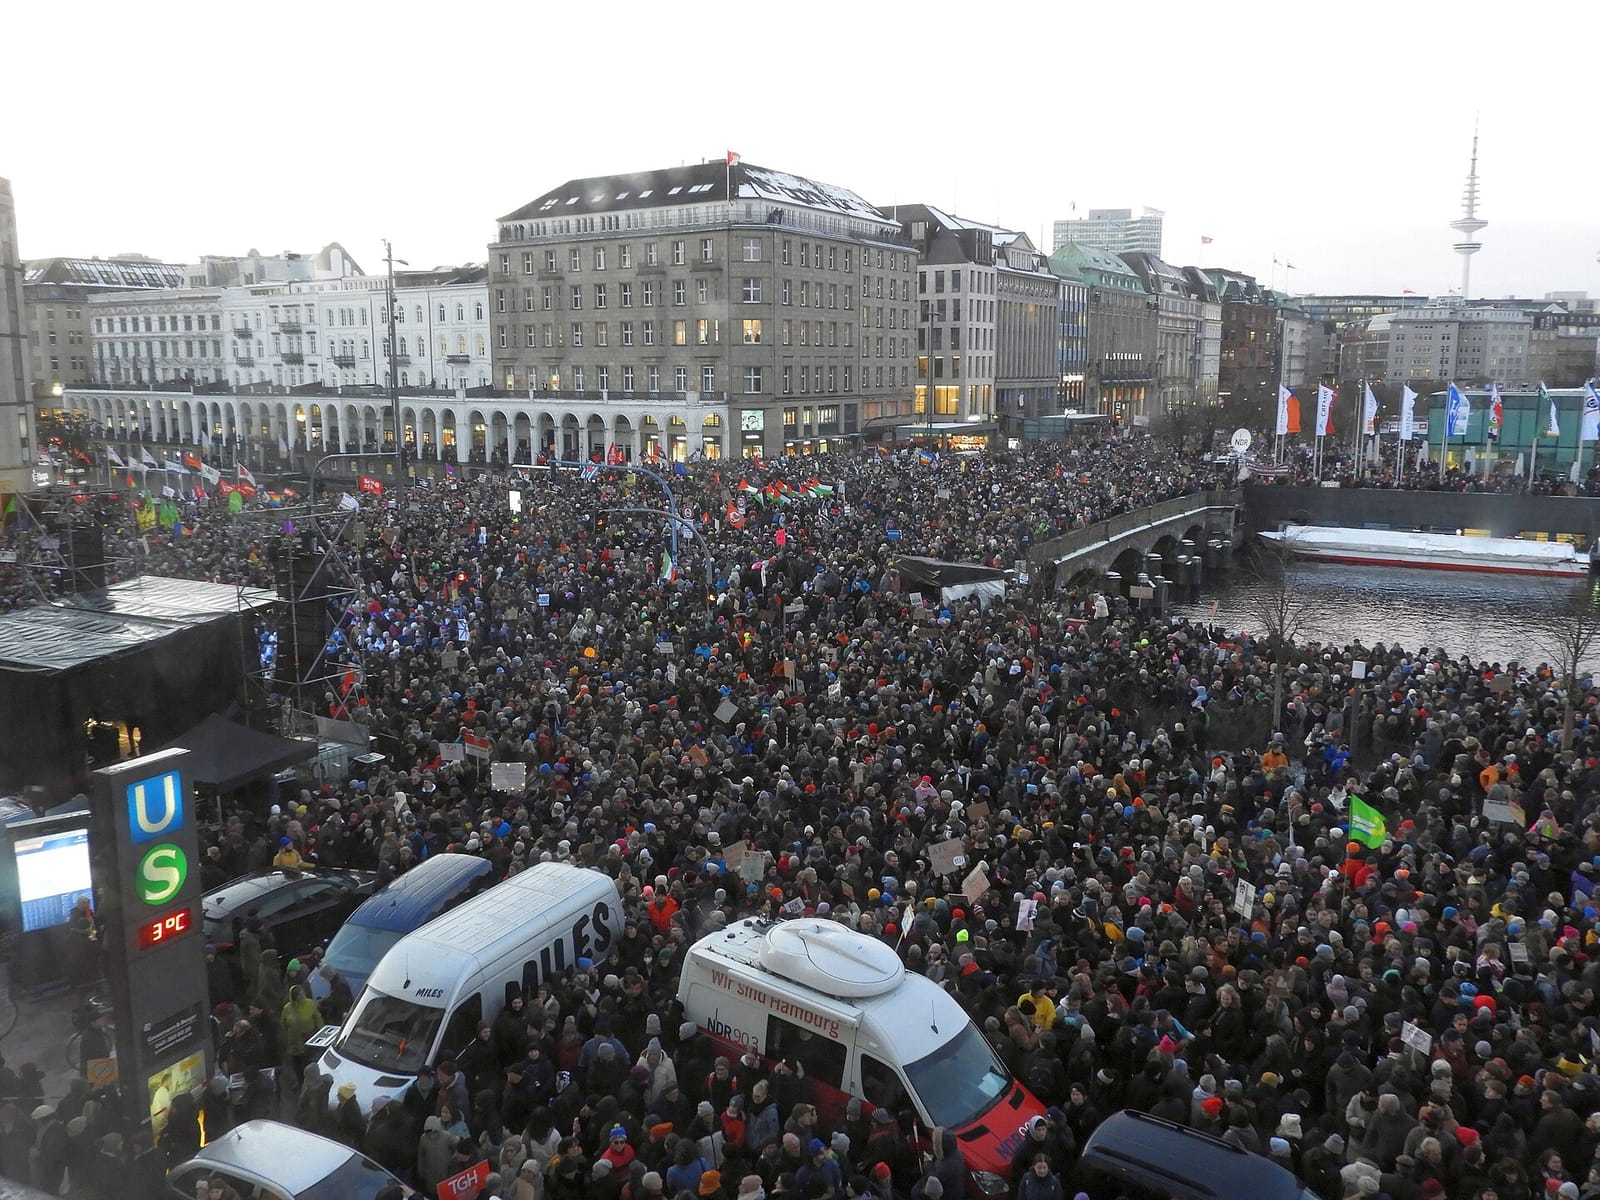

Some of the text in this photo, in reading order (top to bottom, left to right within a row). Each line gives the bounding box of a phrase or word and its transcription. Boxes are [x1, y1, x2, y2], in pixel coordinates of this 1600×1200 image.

[134, 775, 176, 833] U
[143, 849, 180, 900] S
[415, 987, 445, 999] MILES
[707, 1016, 732, 1041] NDR
[769, 996, 840, 1039] Hamburg
[447, 1169, 479, 1194] TGH
